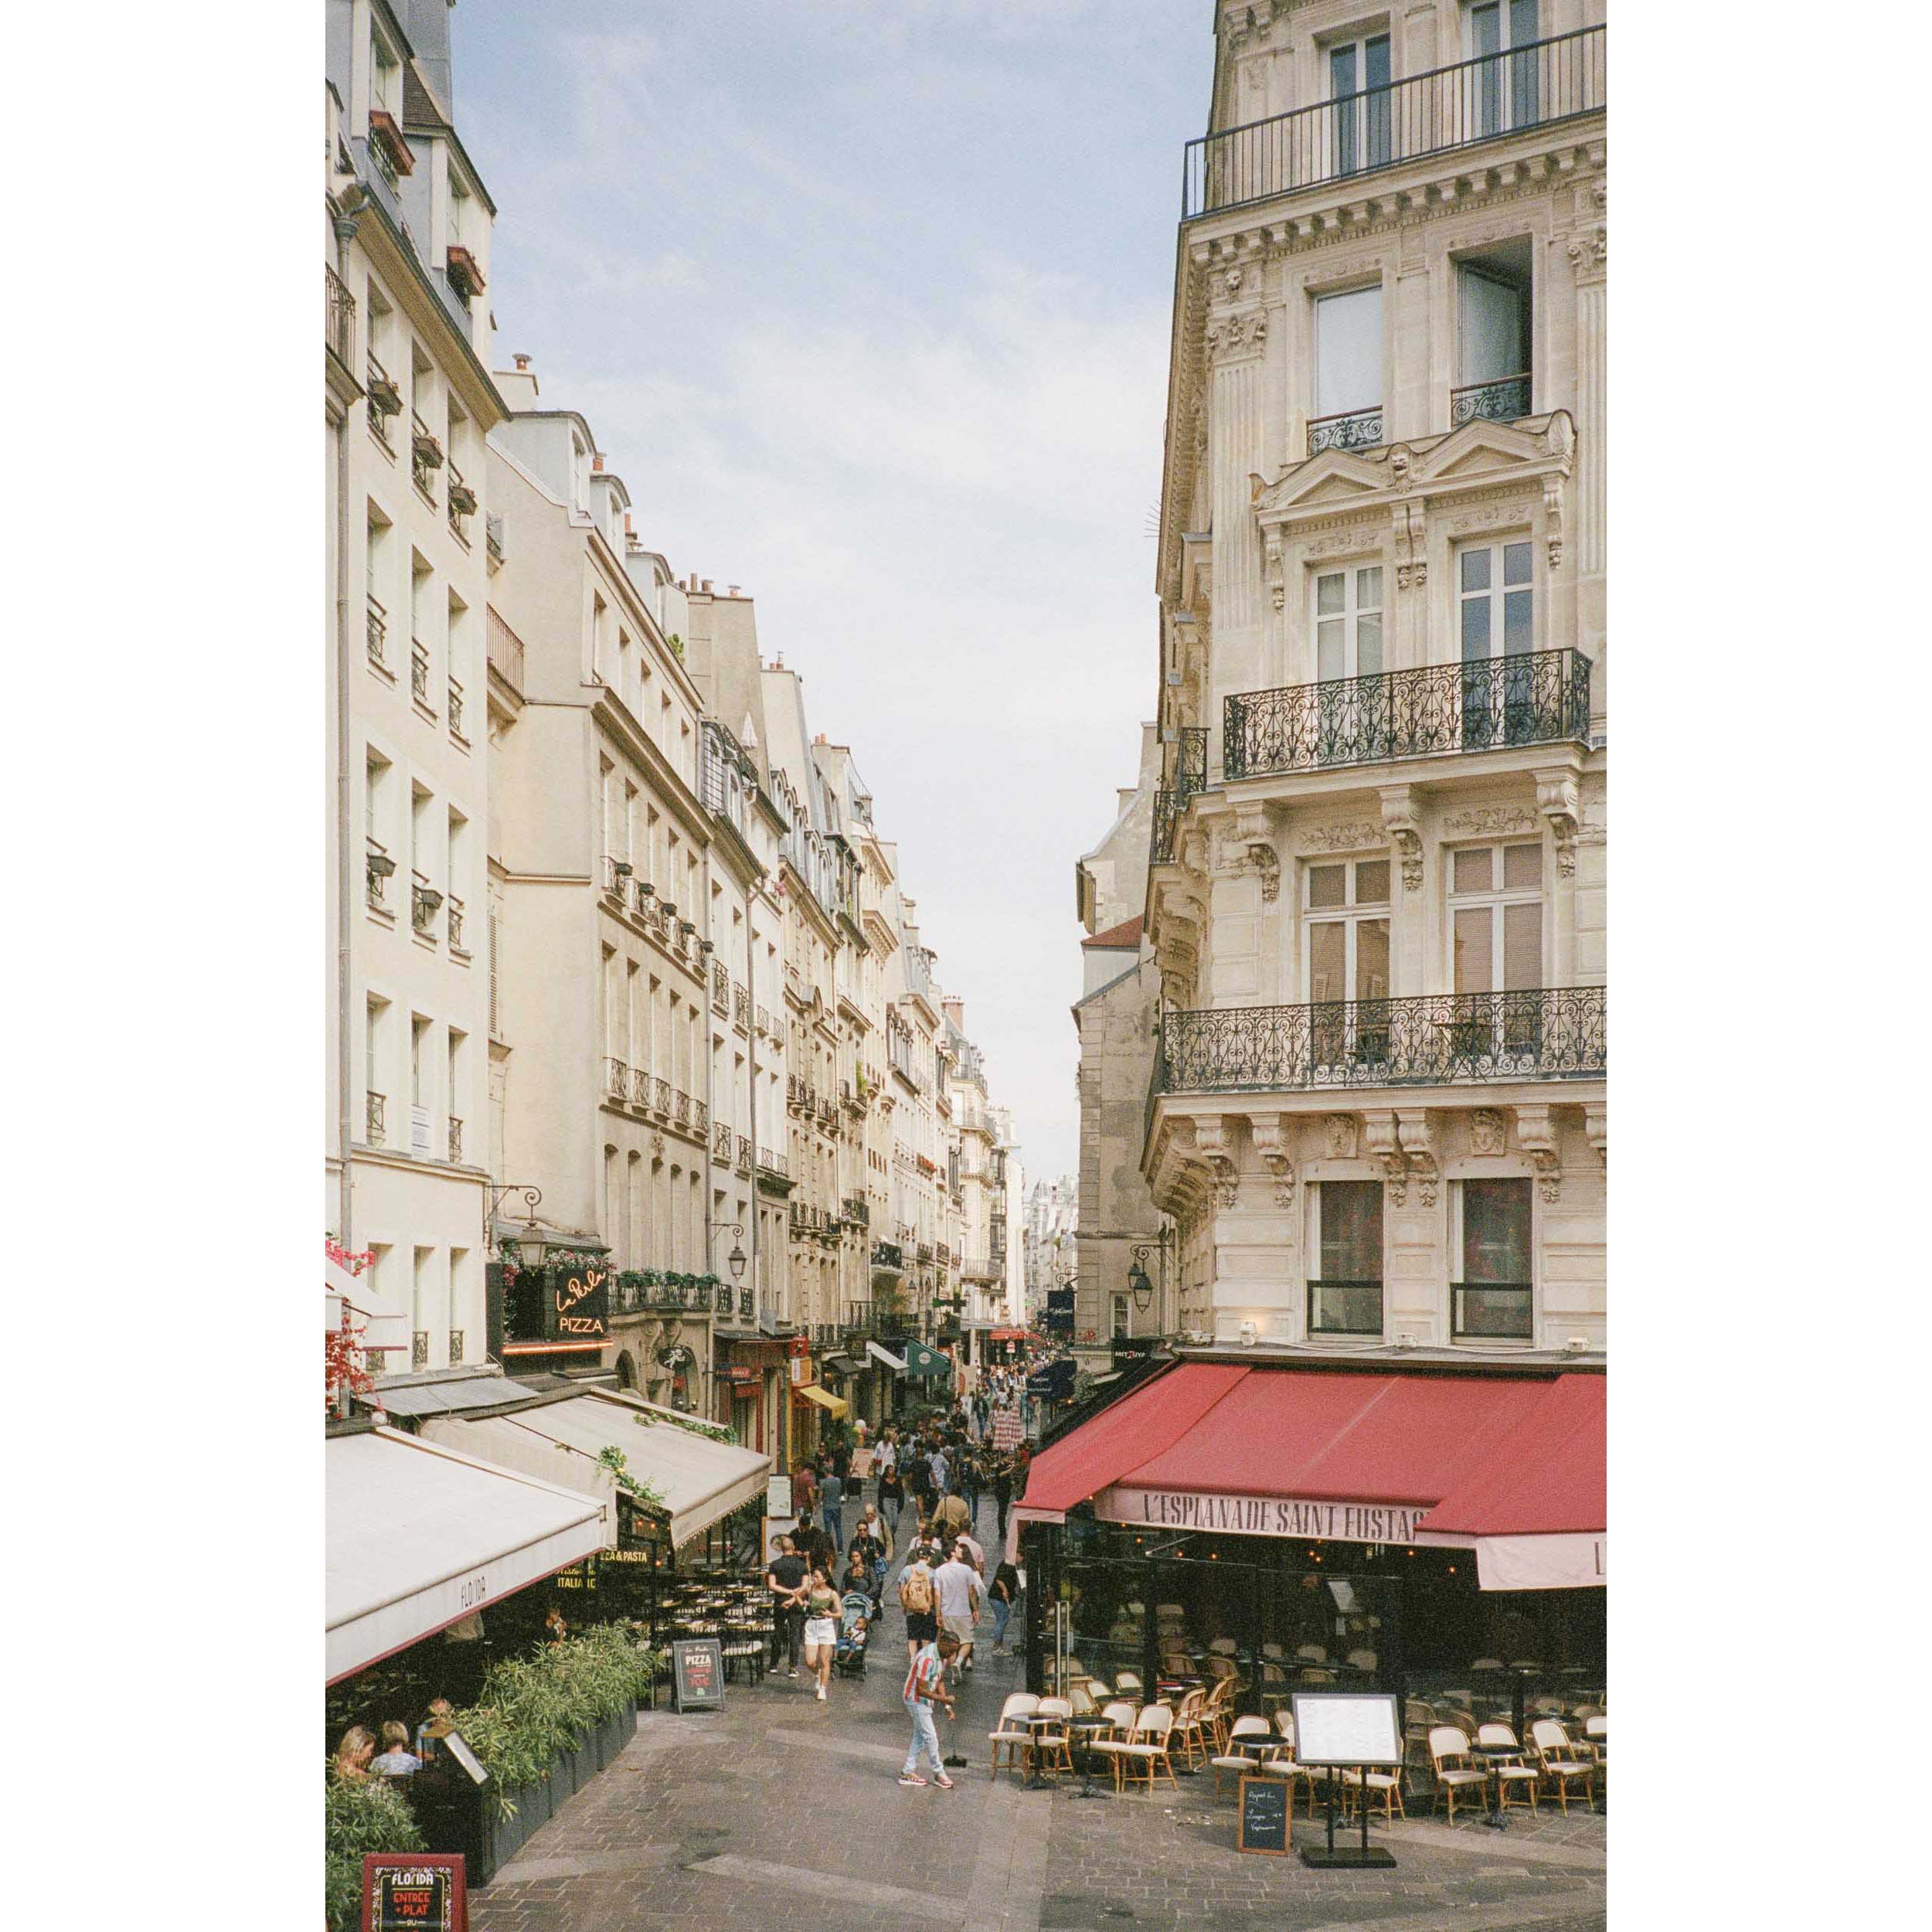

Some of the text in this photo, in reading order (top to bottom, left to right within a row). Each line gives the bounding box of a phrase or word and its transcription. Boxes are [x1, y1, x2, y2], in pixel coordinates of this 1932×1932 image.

[556, 1270, 606, 1311] La Perla
[560, 1317, 604, 1333] PIZZA
[1144, 1494, 1270, 1532] L'ESPLANADE
[1277, 1502, 1337, 1536] SAINT
[685, 1655, 712, 1665] PIZZA
[403, 1903, 428, 1917] PLAT
